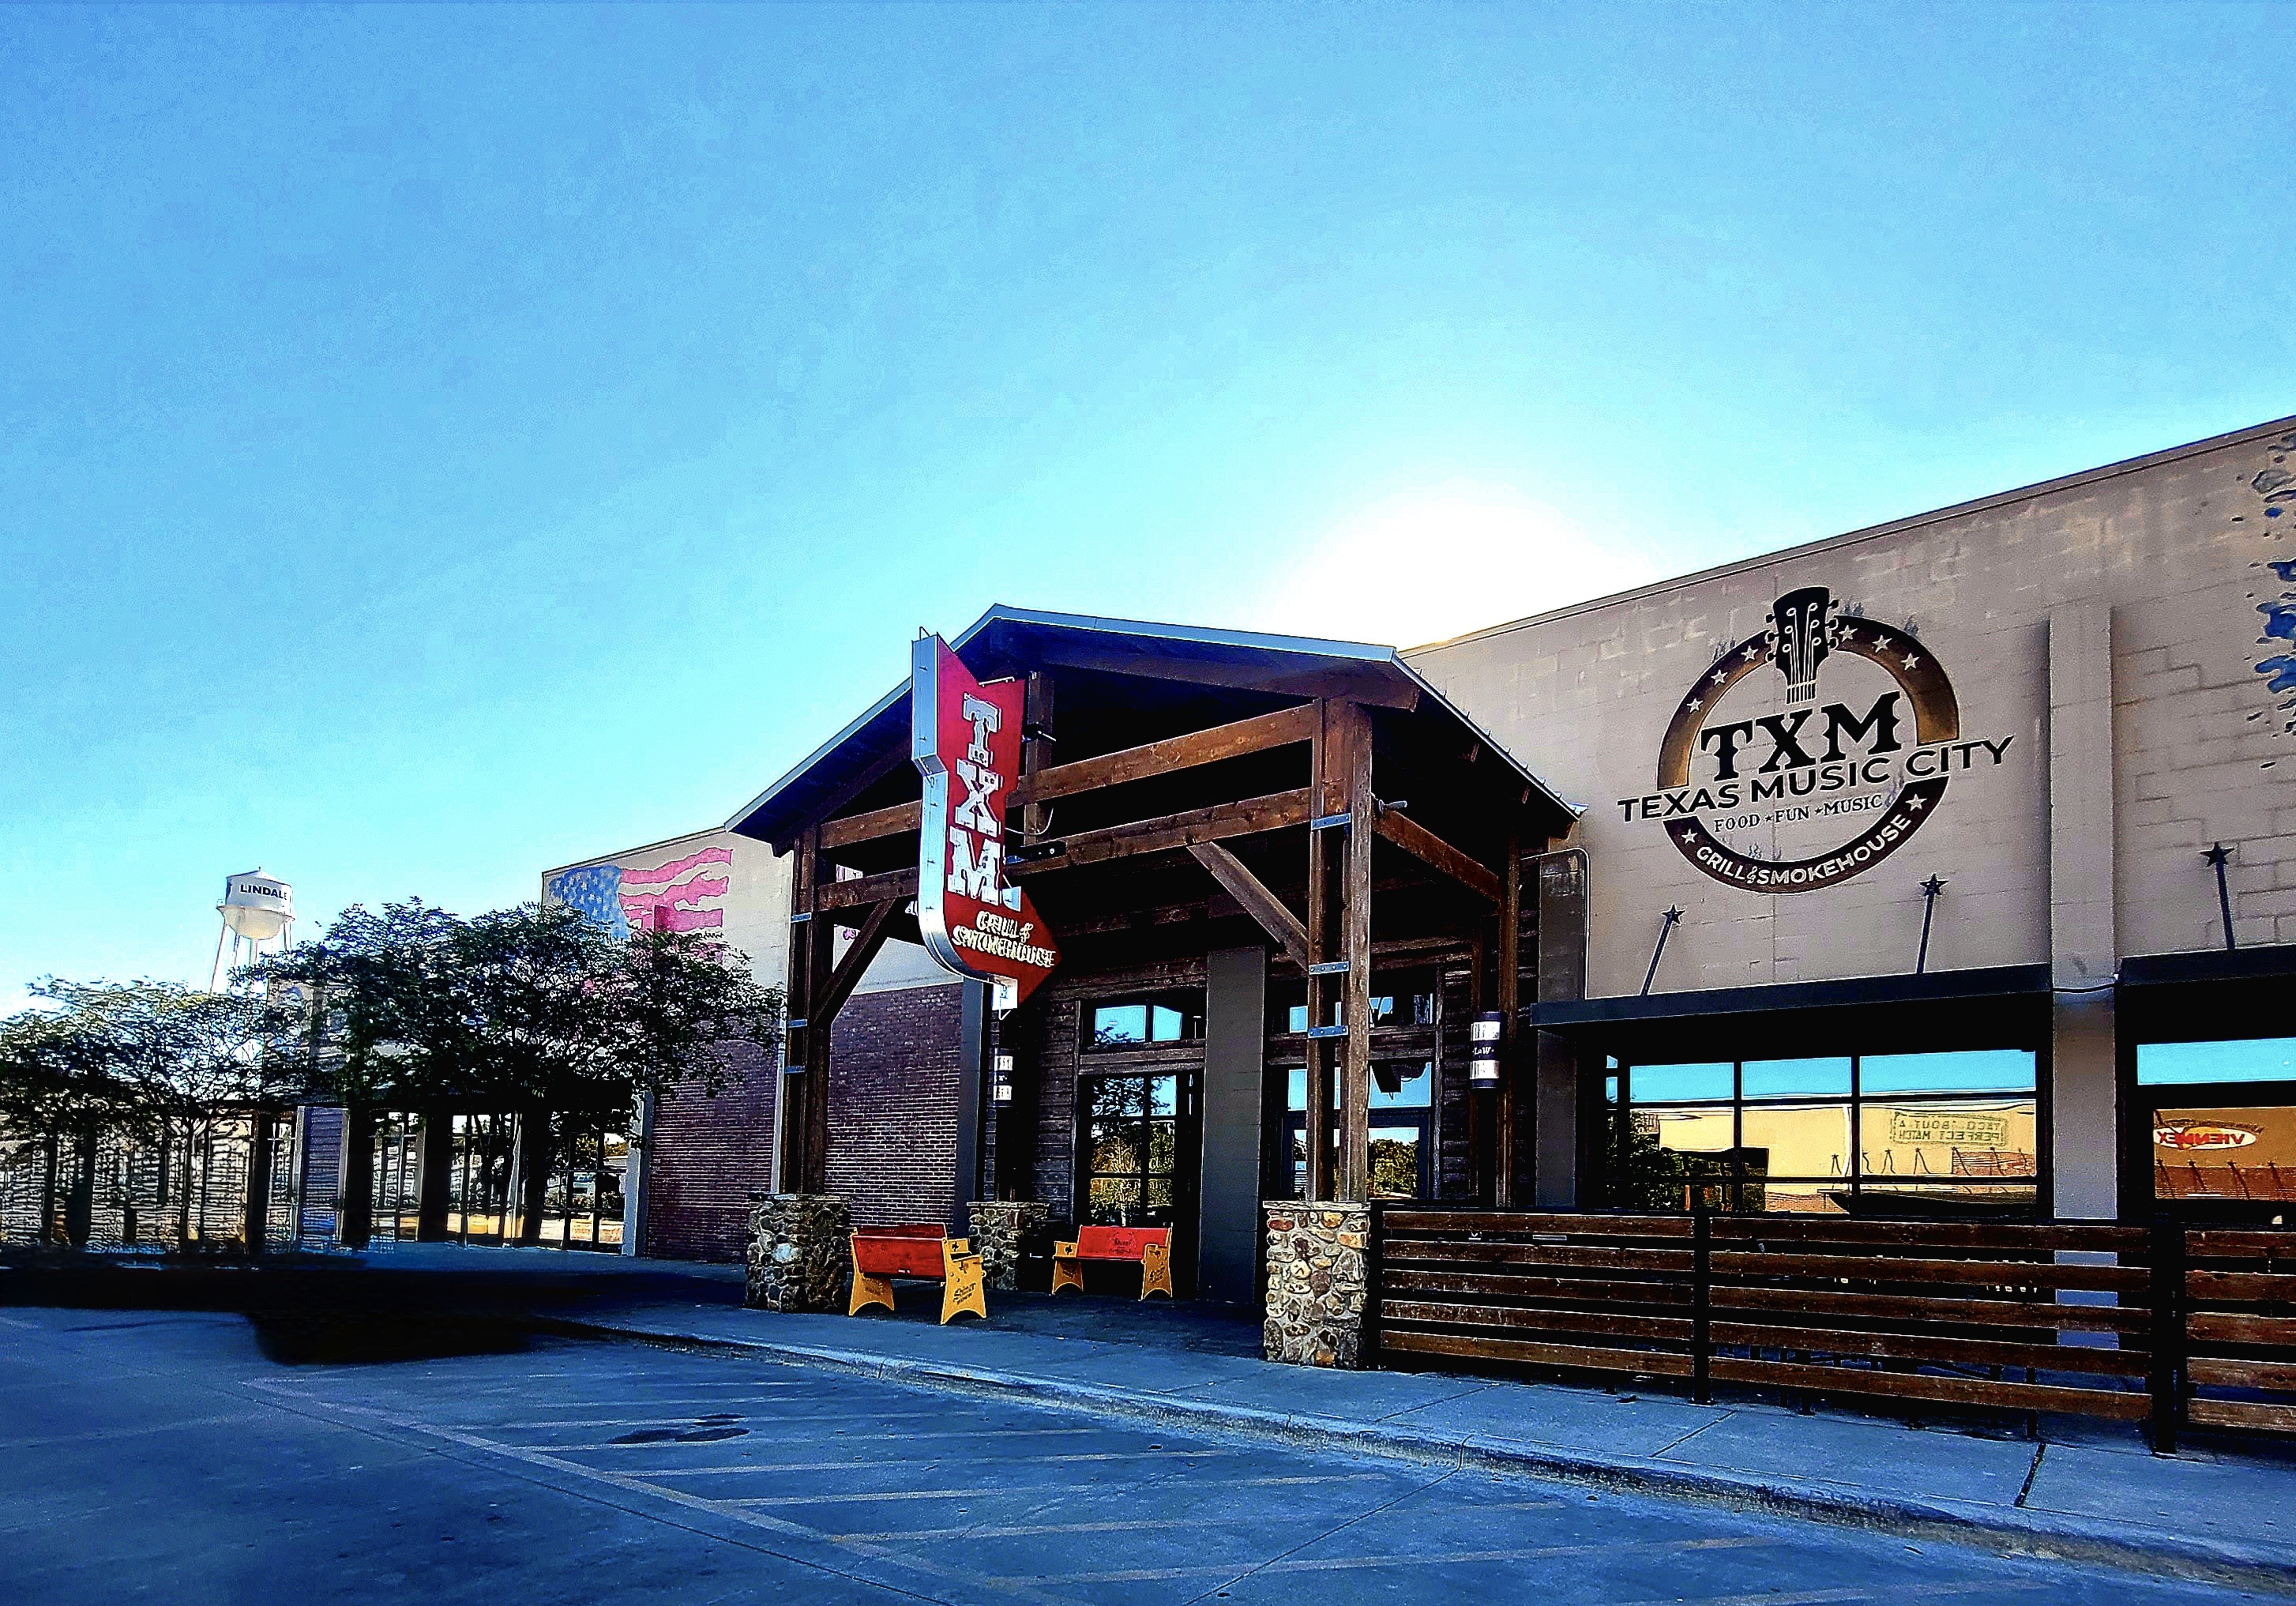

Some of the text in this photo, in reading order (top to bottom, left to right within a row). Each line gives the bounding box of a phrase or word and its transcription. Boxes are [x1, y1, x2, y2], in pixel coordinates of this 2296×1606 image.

[1700, 690, 1902, 782] TXM
[948, 692, 1002, 906] TXM
[1617, 735, 2015, 822] TEXAS MUSIC CITY
[1714, 795, 1884, 833] FOOD FUN MUSIC
[1697, 846, 1745, 881] GRILL
[1757, 814, 1911, 886] SMOKEHOUSE
[240, 884, 287, 900] LINDALE
